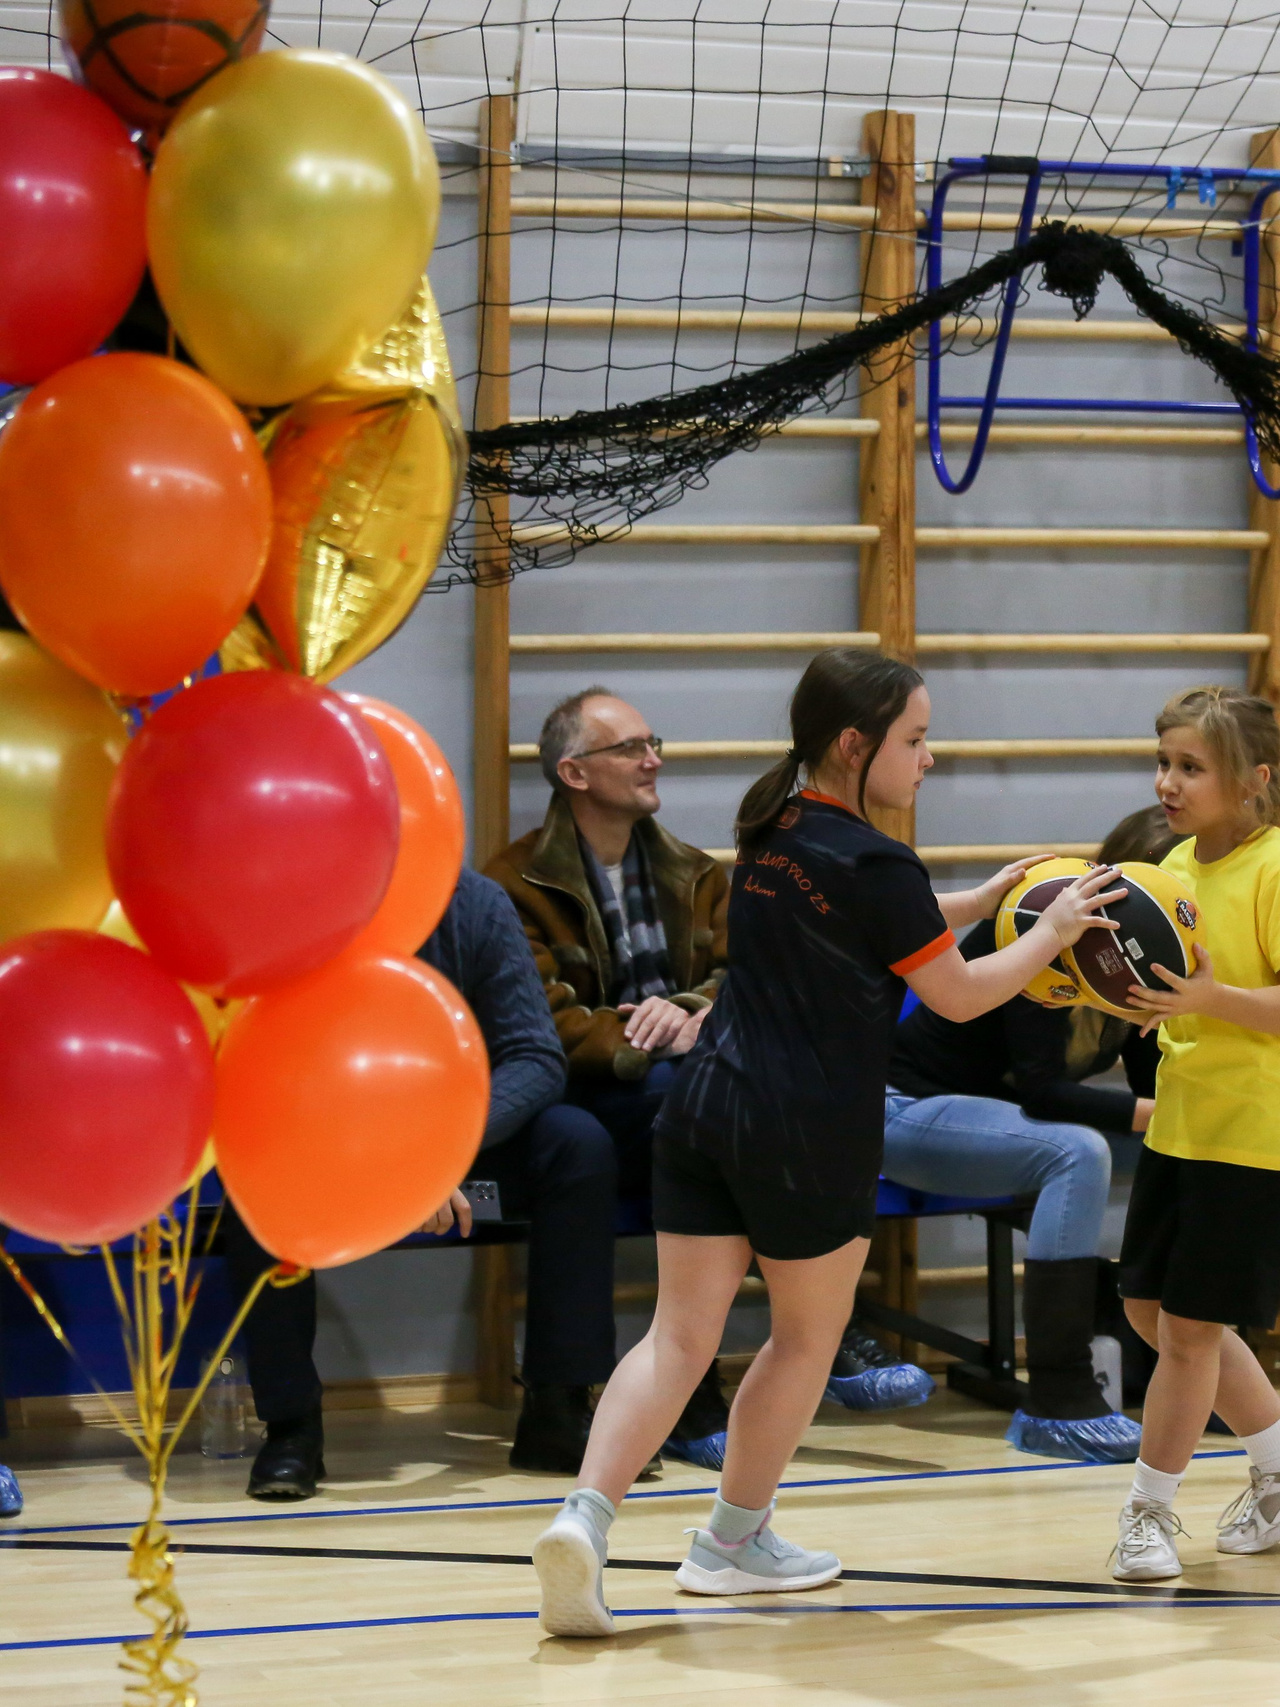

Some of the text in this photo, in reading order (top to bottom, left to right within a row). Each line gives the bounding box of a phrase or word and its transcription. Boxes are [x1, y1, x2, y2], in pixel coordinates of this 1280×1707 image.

[756, 851, 789, 870] CAMP
[785, 863, 812, 890] PRO
[810, 892, 831, 914] 23
